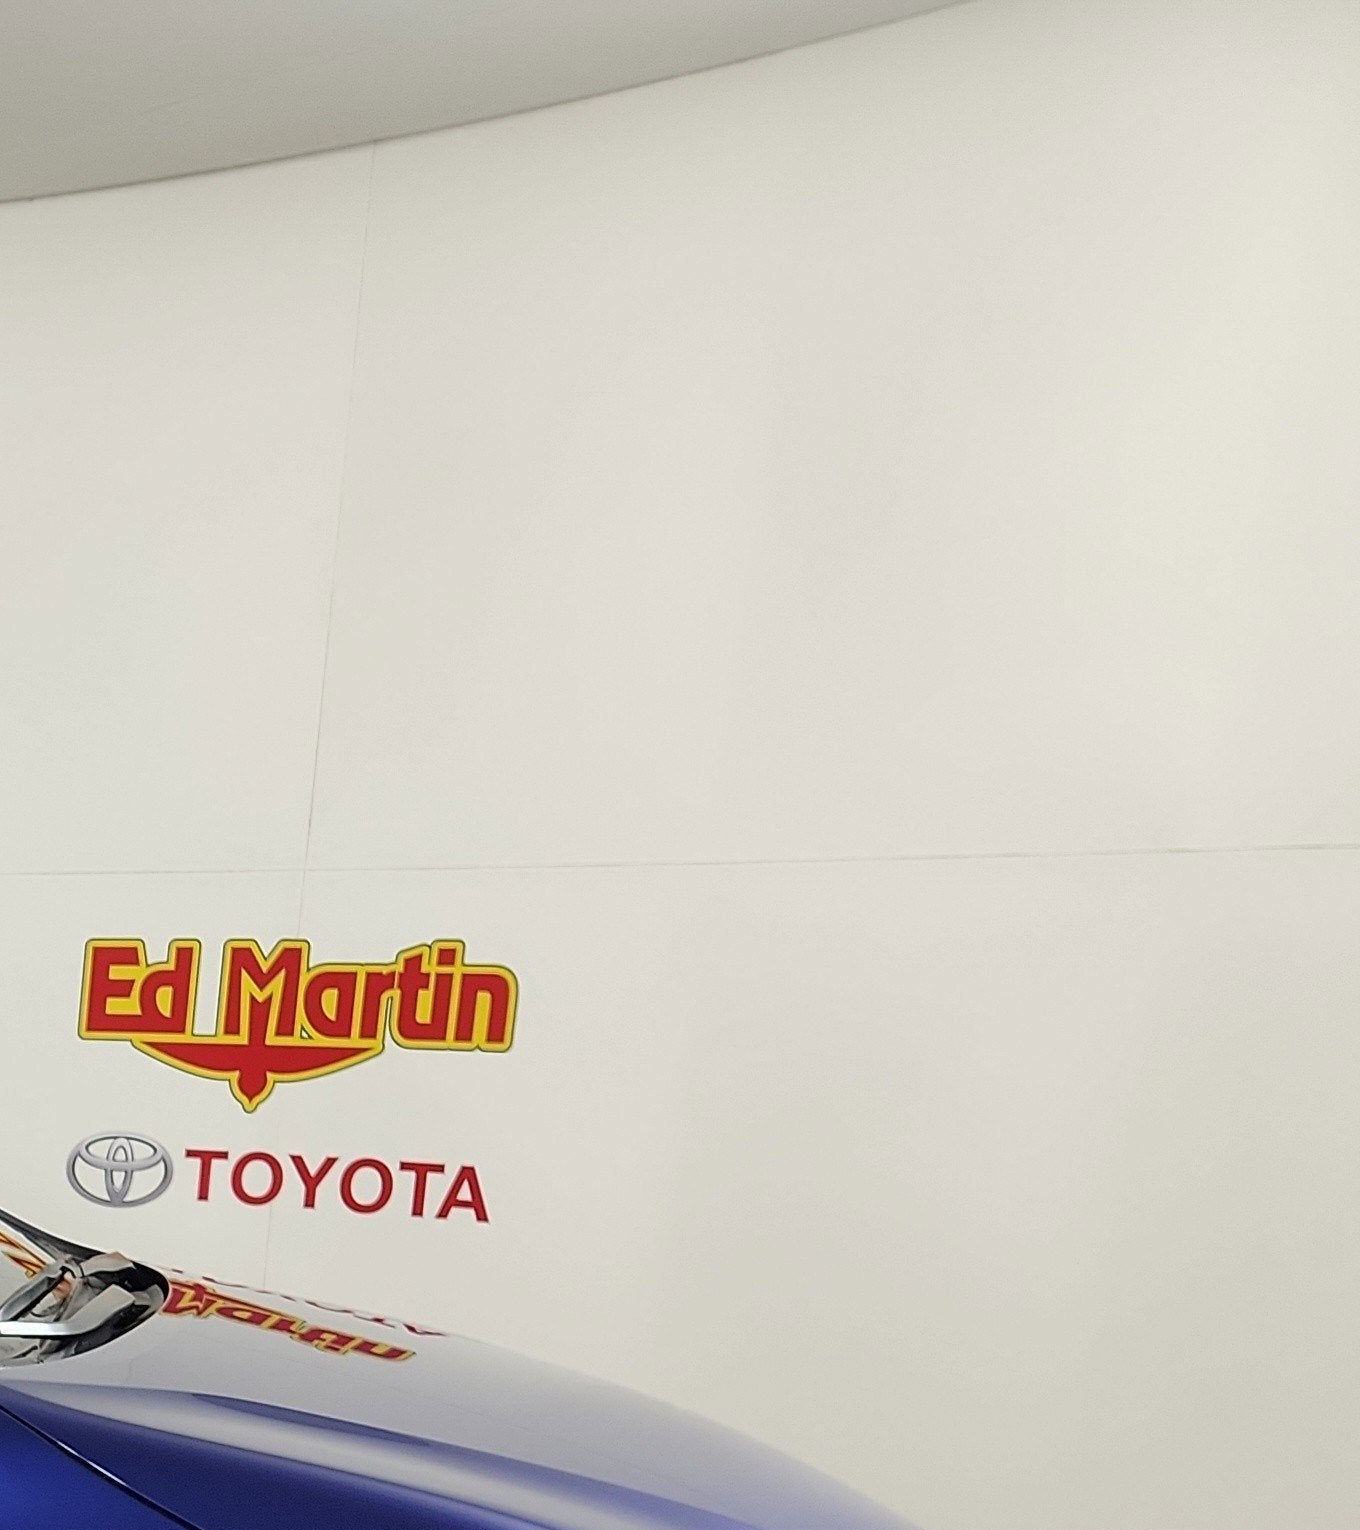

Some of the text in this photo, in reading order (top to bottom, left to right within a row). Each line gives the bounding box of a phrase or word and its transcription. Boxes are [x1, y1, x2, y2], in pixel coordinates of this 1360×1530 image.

[84, 944, 513, 1045] Ed Martin
[184, 1148, 490, 1224] TOYOTA
